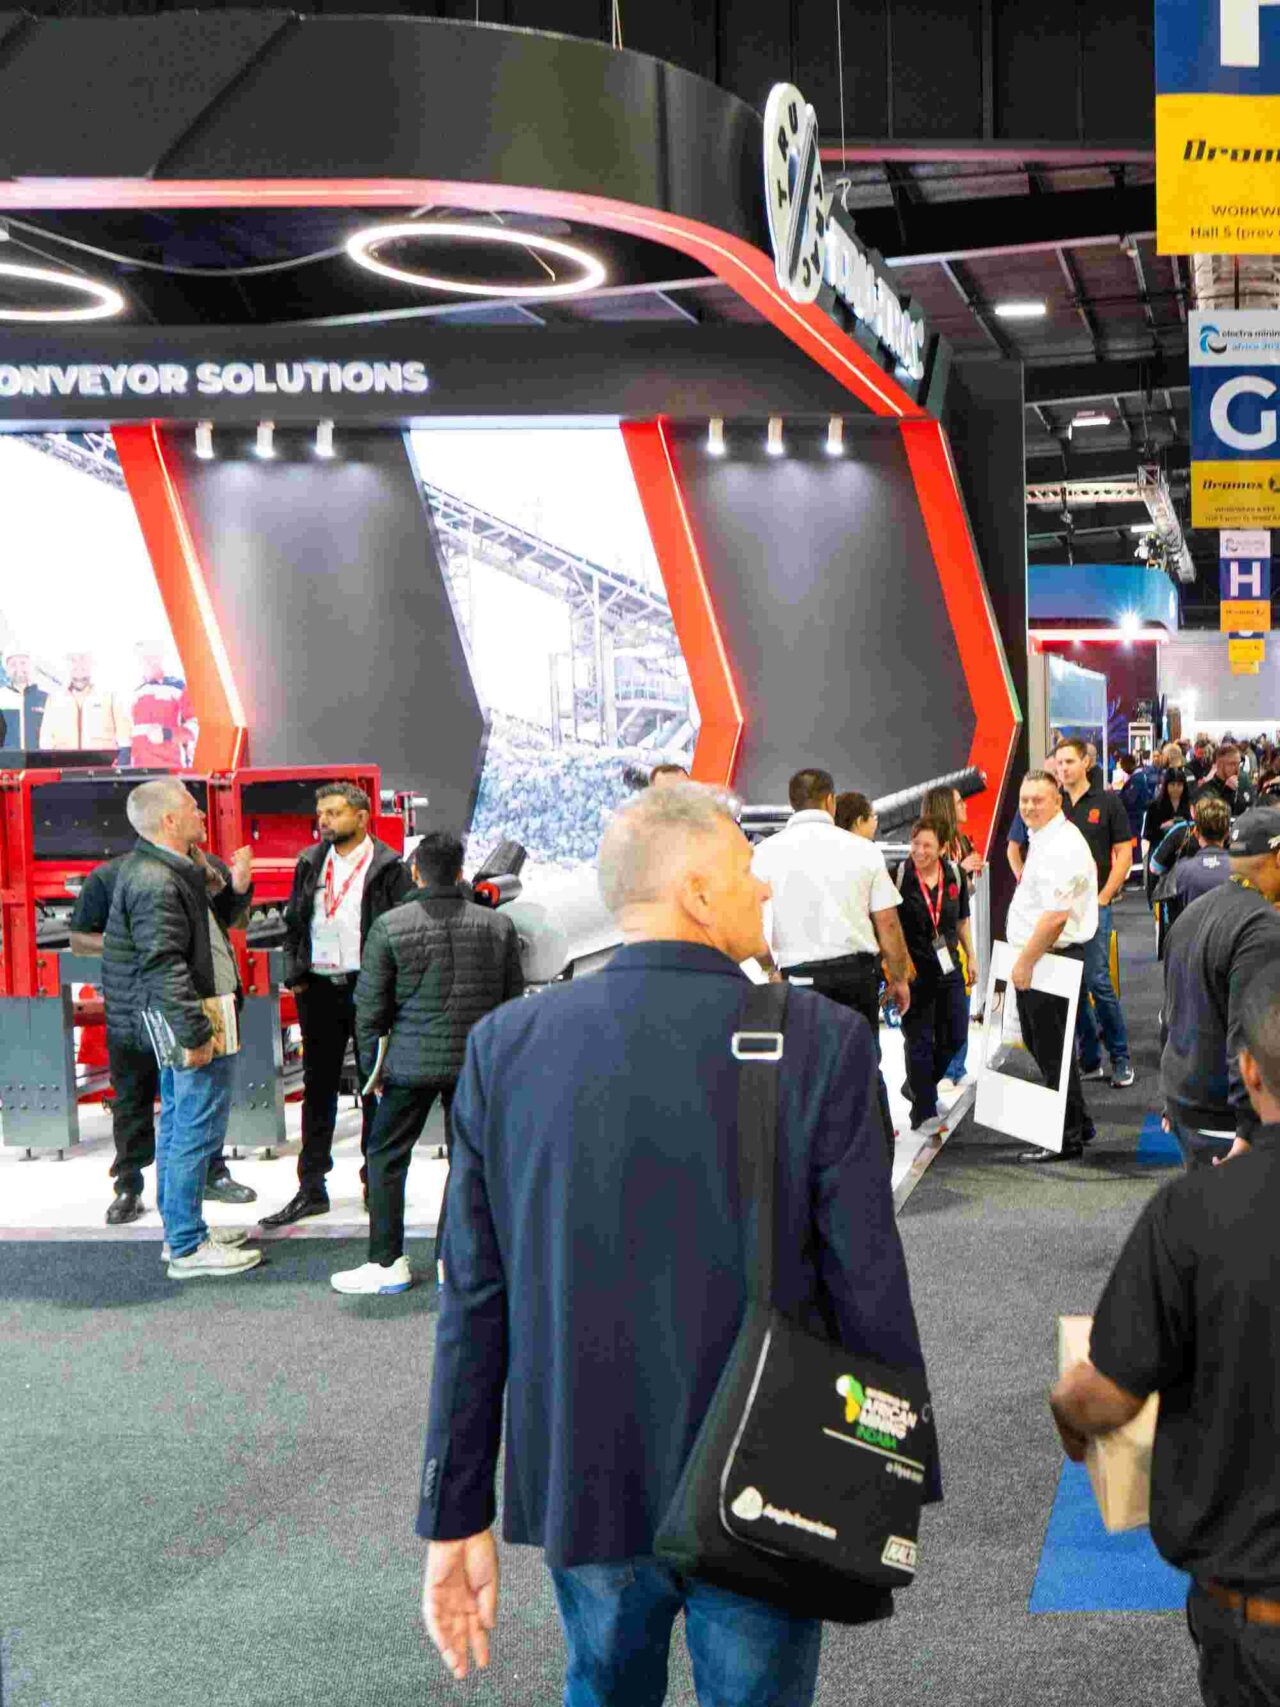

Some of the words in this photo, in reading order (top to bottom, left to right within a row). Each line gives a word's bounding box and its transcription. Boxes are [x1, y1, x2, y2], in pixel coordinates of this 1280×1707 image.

[1190, 226, 1218, 239] Hall
[1236, 226, 1274, 241] (prev
[197, 361, 429, 394] SOLUTIONS
[1210, 375, 1277, 451] G
[1230, 561, 1261, 597] H
